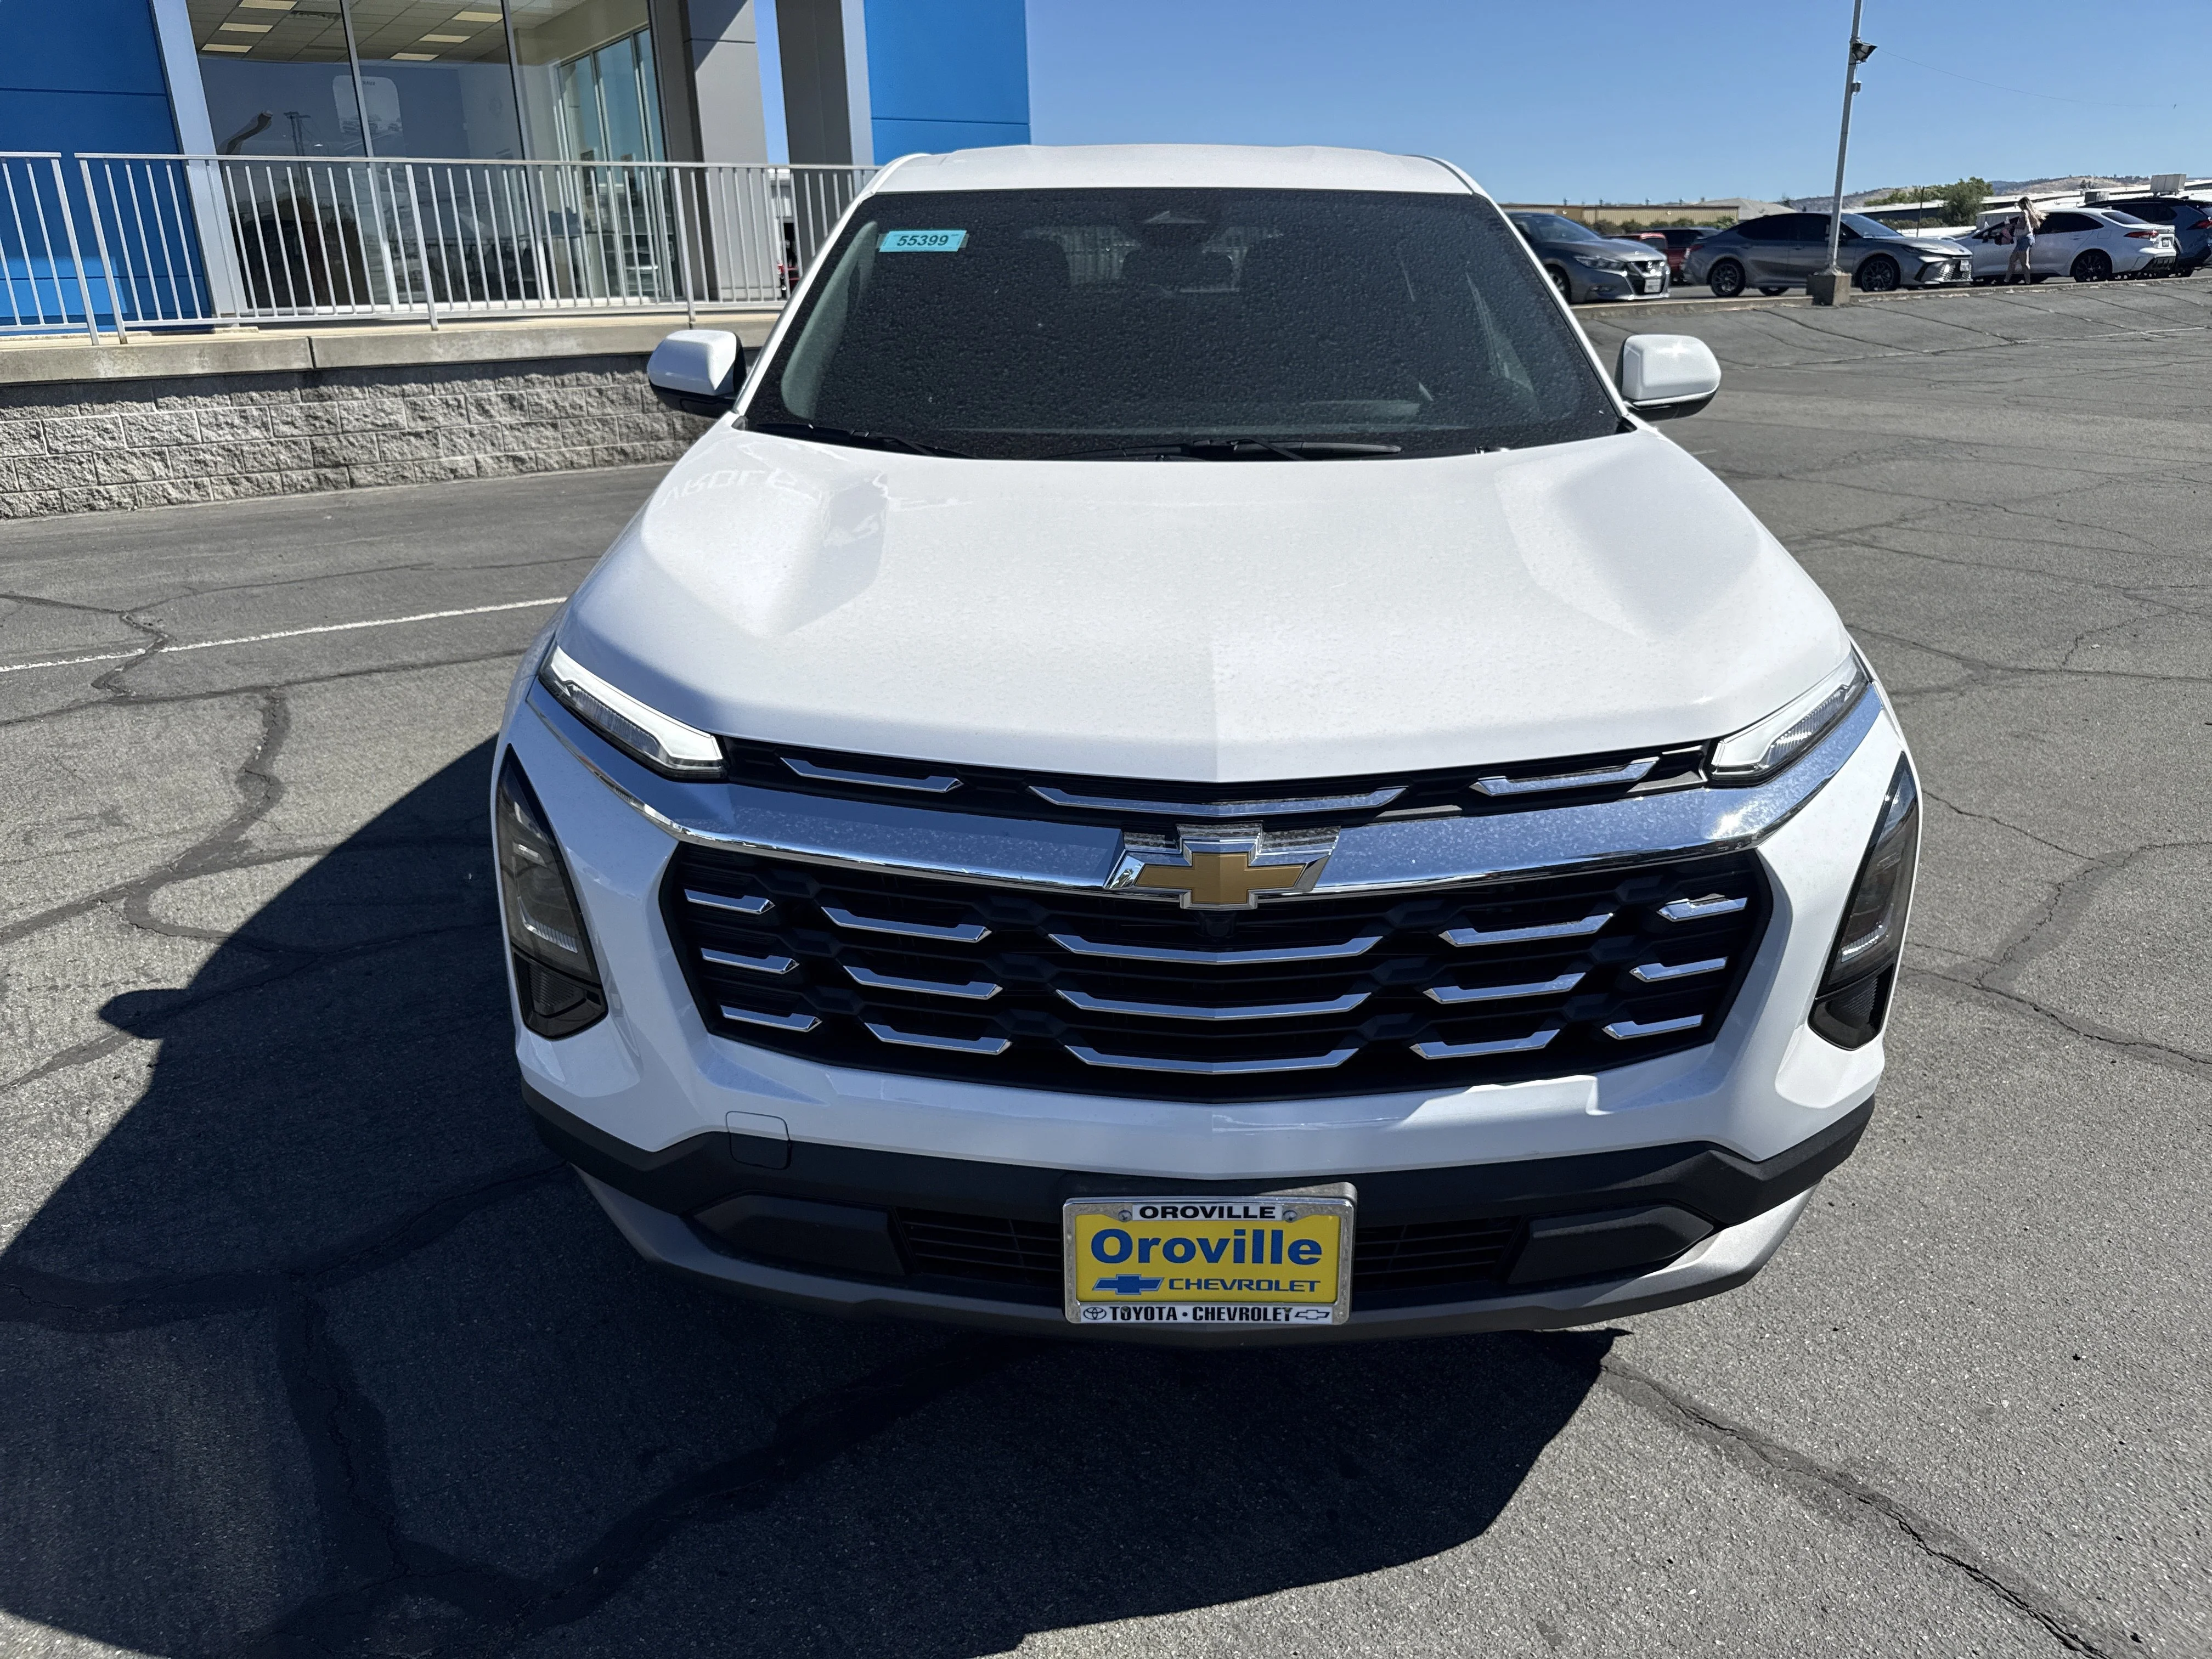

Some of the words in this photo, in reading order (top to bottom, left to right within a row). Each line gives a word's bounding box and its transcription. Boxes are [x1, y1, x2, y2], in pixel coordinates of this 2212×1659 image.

[897, 235, 949, 246] 55399
[1139, 1205, 1276, 1219] OROVILLE
[1091, 1228, 1322, 1265] Oroville
[1169, 1278, 1321, 1293] CHEVROLET
[1109, 1307, 1177, 1321] TOYOTA
[1192, 1307, 1292, 1322] CHEVROLET
